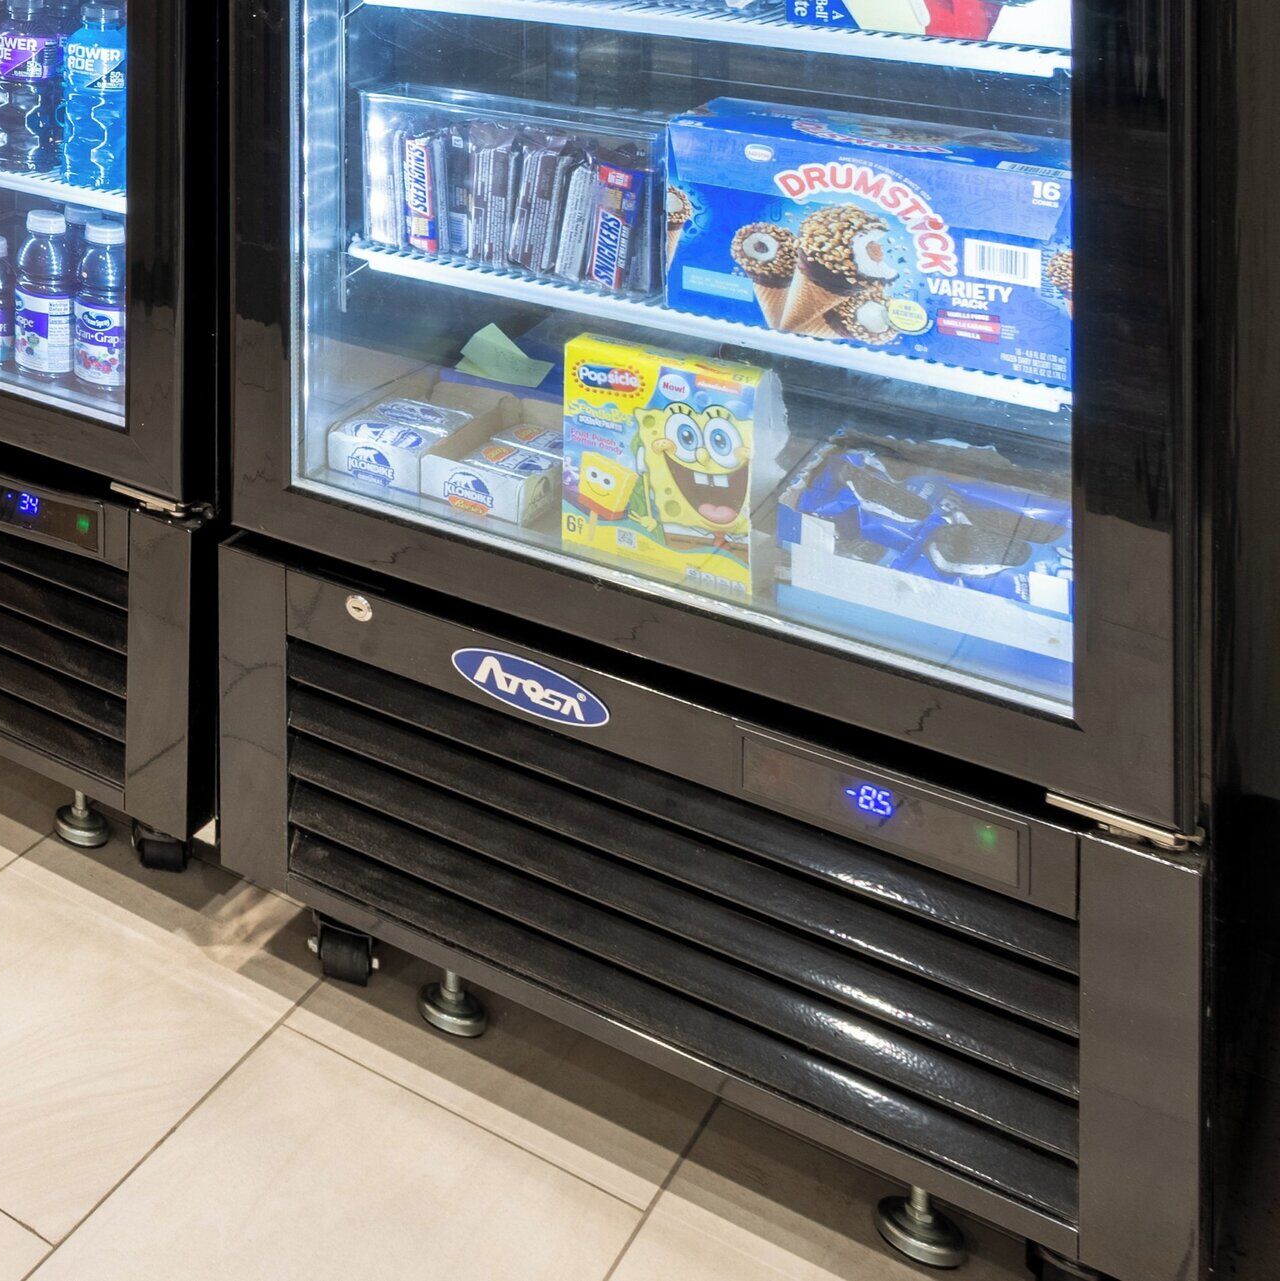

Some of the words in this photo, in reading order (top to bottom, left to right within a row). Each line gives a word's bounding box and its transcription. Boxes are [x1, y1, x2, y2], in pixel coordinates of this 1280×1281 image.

[67, 44, 121, 62] POWER
[1031, 180, 1061, 200] 16
[1031, 198, 1059, 208] CONES
[775, 162, 957, 276] DRUMSTICK
[593, 211, 622, 287] SNICKERS
[926, 278, 1013, 303] VARIETY
[951, 297, 989, 310] PACK
[580, 367, 639, 388] Popsicle
[663, 382, 686, 393] Now!
[347, 455, 395, 481] KLONDIKE
[19, 493, 39, 514] 34
[443, 482, 494, 508] KLONDIKE
[566, 516, 577, 534] 6
